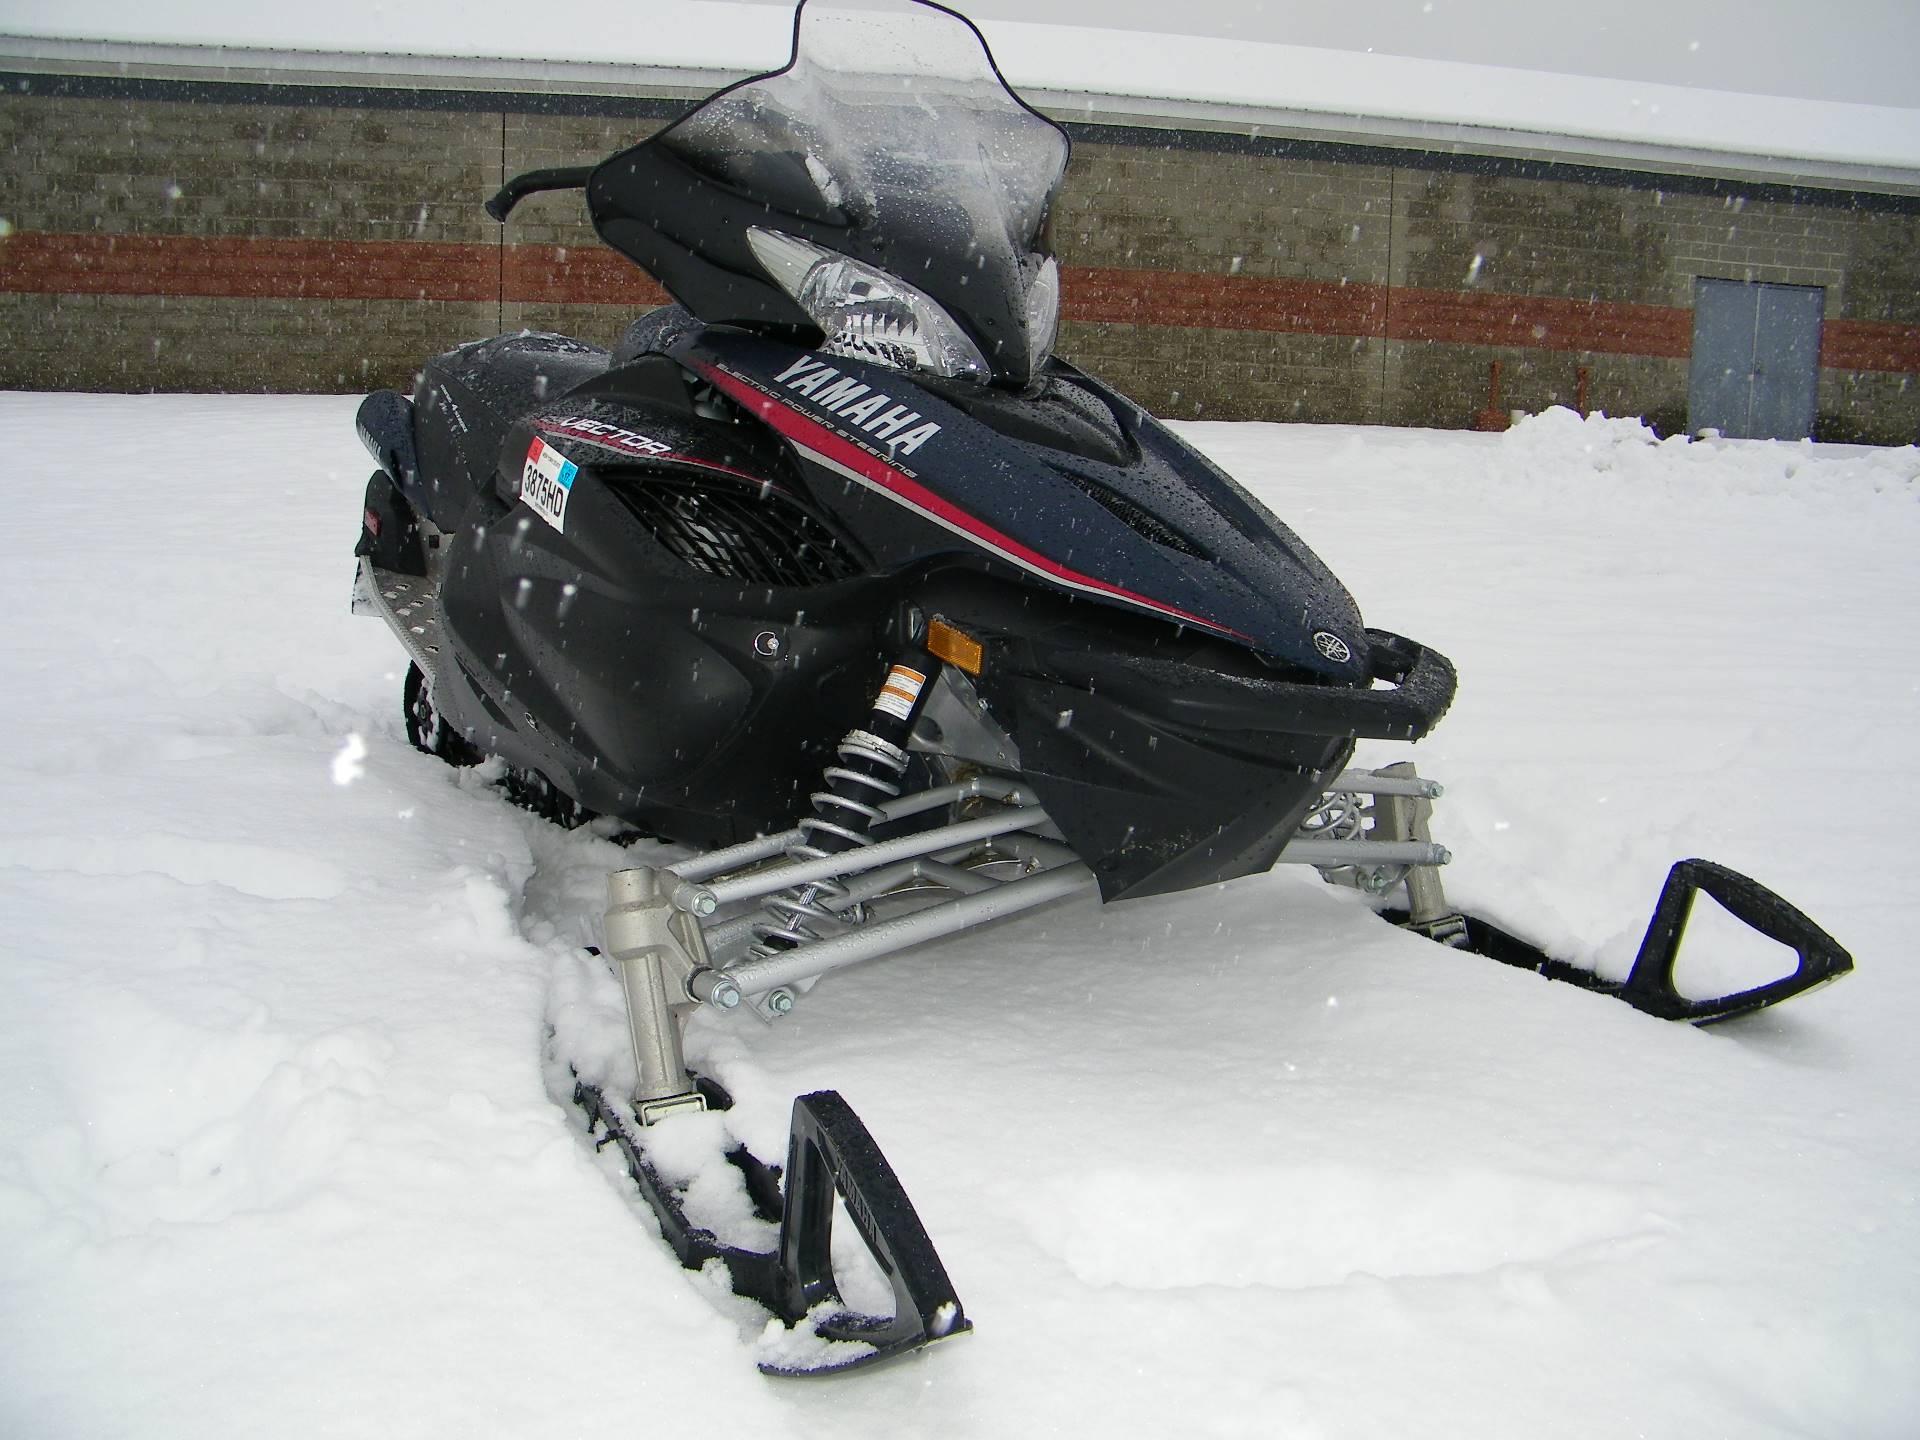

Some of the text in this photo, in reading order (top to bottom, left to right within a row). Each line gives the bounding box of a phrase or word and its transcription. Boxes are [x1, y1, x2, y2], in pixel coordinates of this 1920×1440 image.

[561, 417, 672, 455] VECTOR
[716, 363, 918, 478] ELECTRIC POWER STEERING
[773, 355, 942, 456] YAMAHA
[524, 464, 564, 518] 3875HD
